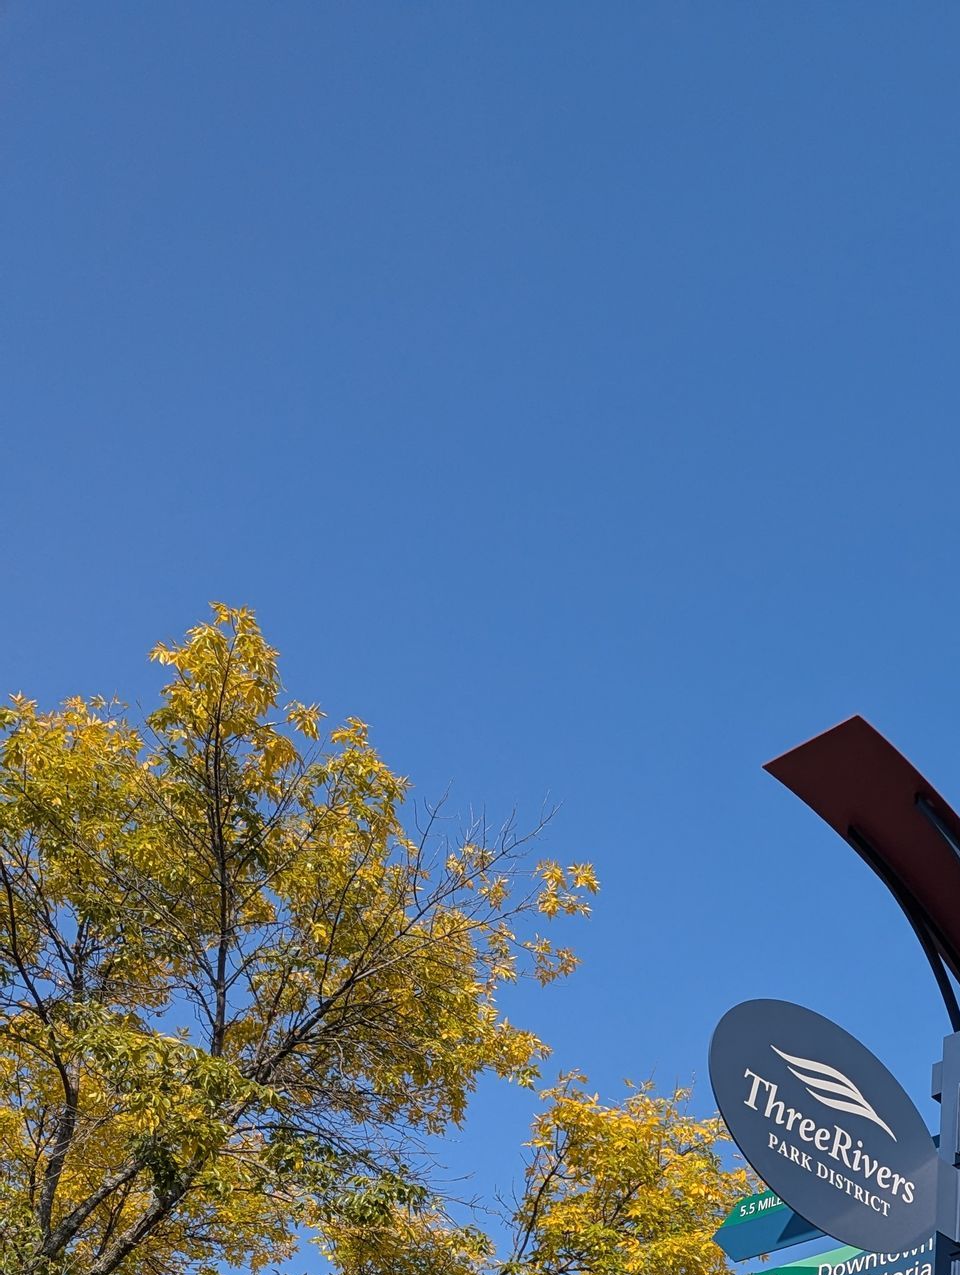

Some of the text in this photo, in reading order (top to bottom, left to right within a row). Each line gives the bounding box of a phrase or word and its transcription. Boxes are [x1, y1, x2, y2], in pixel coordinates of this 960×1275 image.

[744, 1068, 915, 1204] ThreeRivers
[768, 1132, 891, 1217] PARK DISTRICT
[740, 1196, 783, 1217] 5.5 MILE
